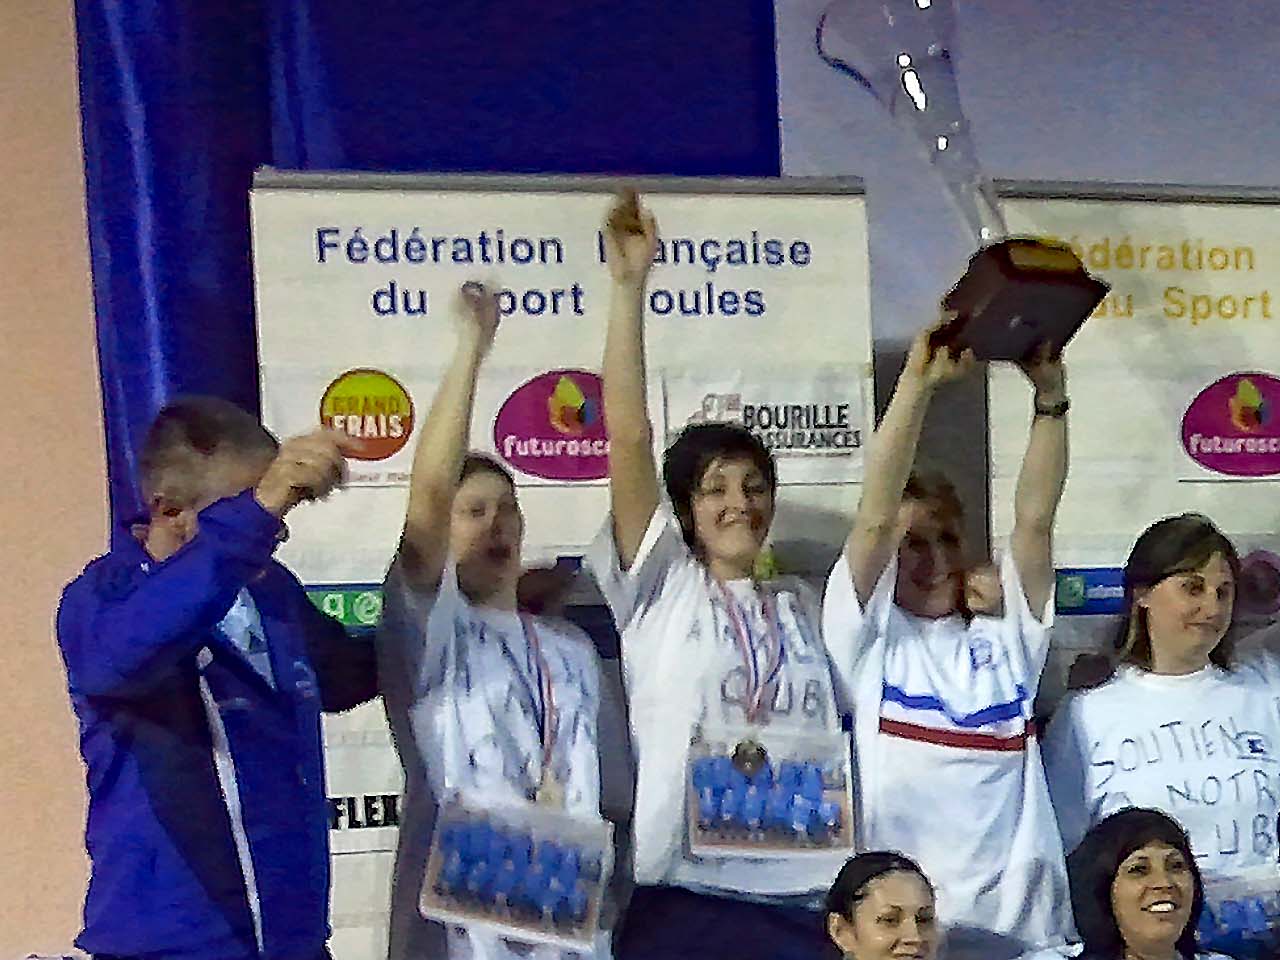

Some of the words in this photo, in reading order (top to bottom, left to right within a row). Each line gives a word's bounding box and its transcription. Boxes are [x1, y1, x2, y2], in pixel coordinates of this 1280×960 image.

[315, 226, 564, 264] Fédération
[597, 229, 812, 272] ançaise
[371, 279, 429, 316] du
[494, 281, 585, 316] port
[649, 280, 766, 316] oules
[1162, 288, 1272, 327] Sport
